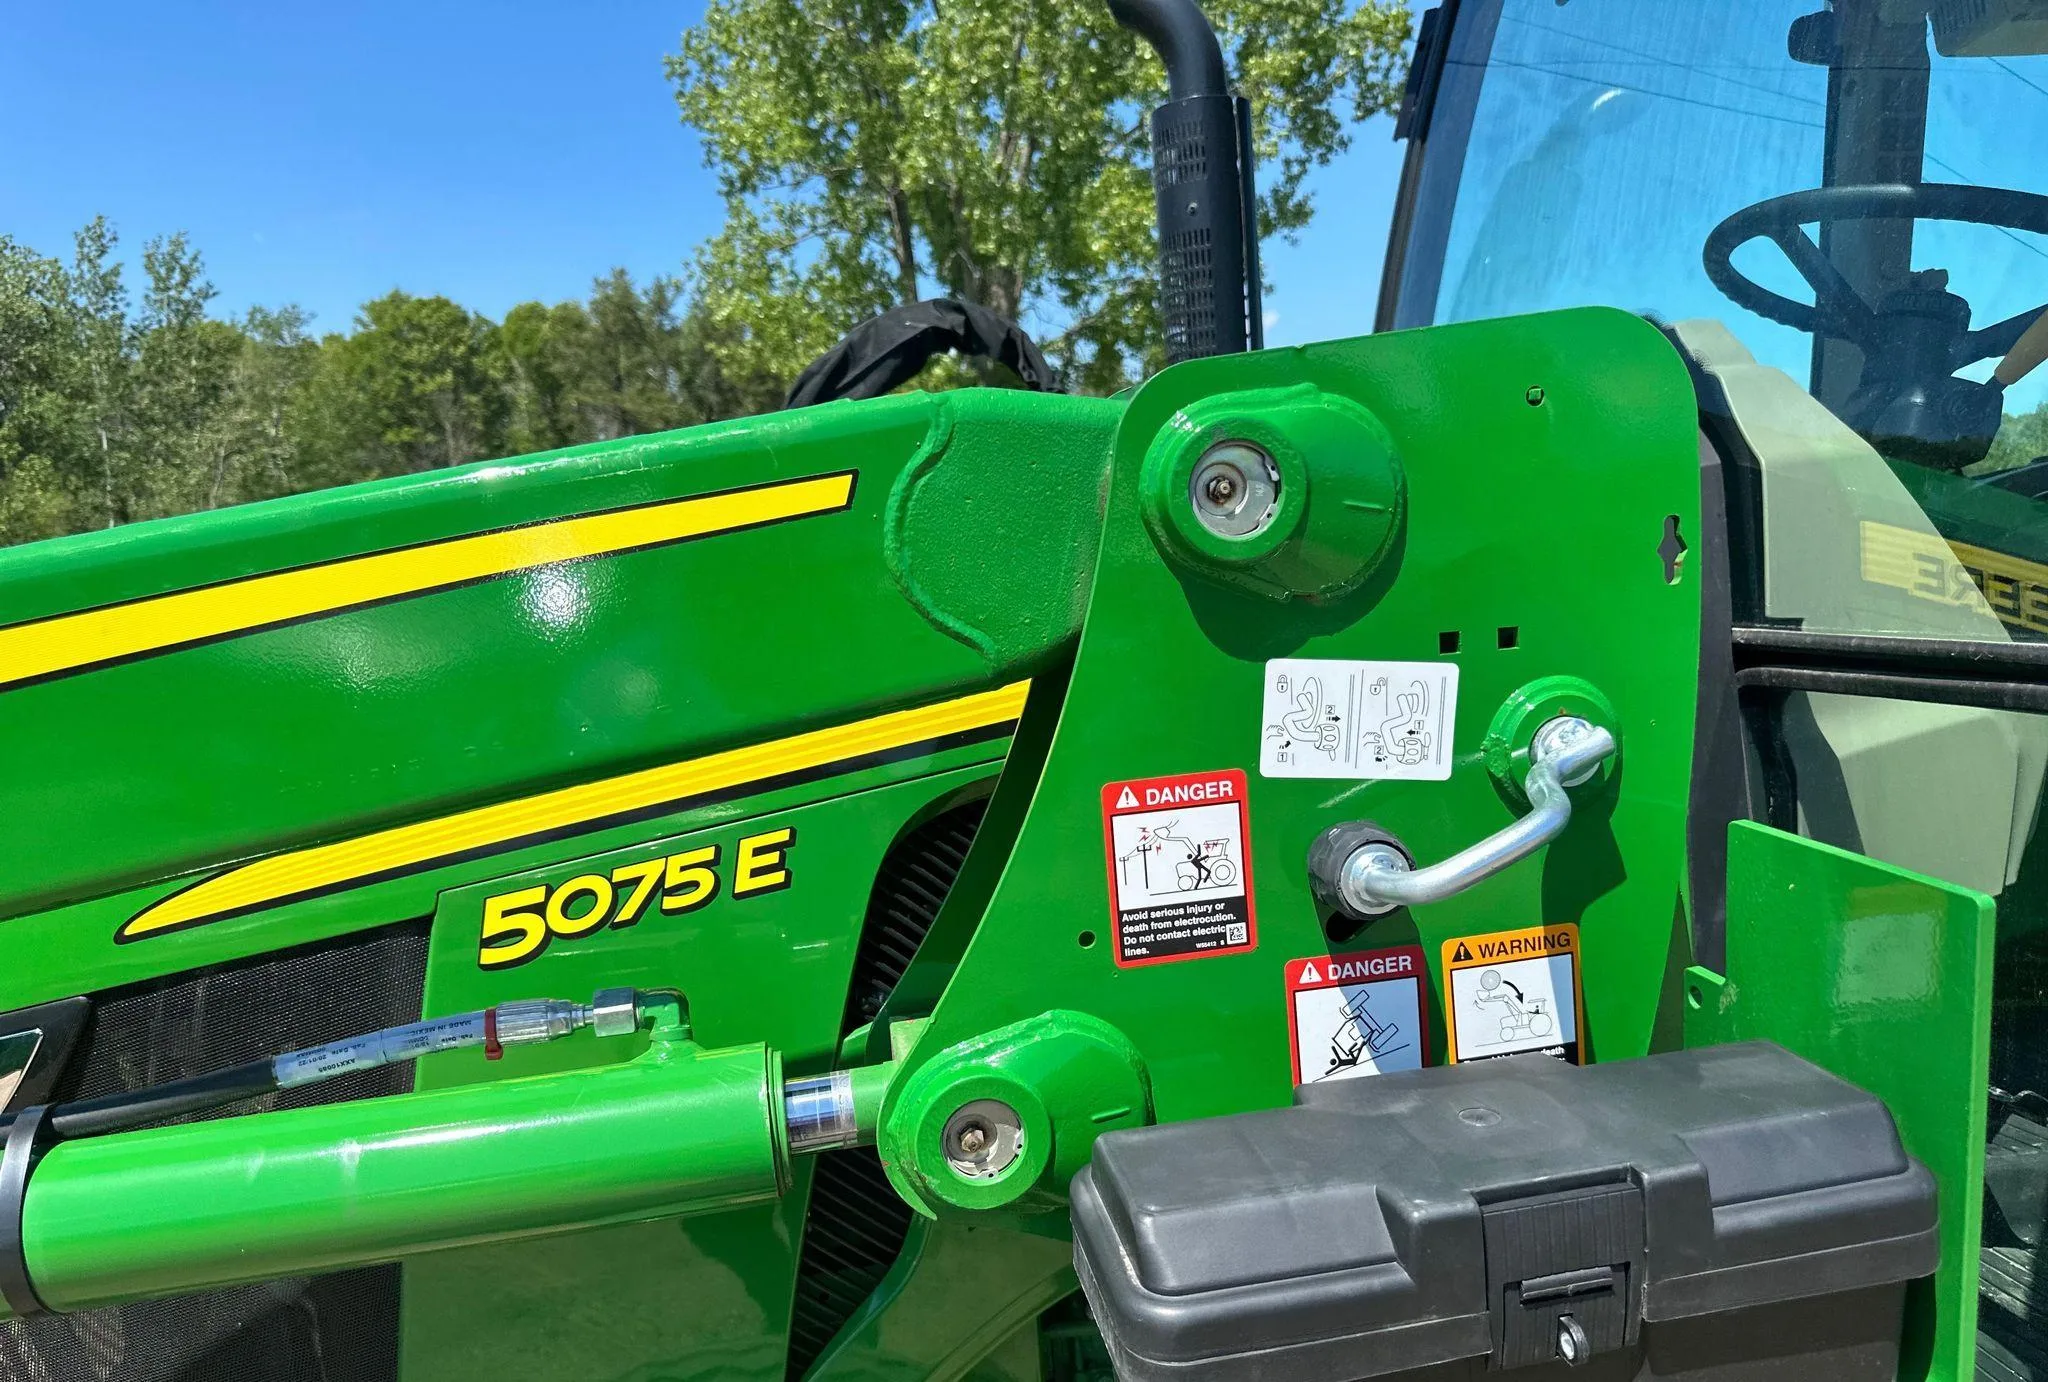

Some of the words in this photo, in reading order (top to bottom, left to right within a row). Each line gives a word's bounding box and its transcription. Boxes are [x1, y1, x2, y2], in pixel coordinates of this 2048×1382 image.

[1145, 780, 1234, 806] DANGER
[478, 843, 722, 972] 5075
[732, 826, 797, 900] E
[1121, 911, 1149, 923] Avoid
[1150, 906, 1185, 919] serious
[1186, 904, 1213, 916] injury
[1215, 902, 1226, 911] or
[1122, 923, 1149, 934] death
[1150, 919, 1173, 930] from
[1174, 913, 1237, 927] electrocution.
[1123, 936, 1137, 946] Do
[1138, 933, 1155, 943] not
[1156, 929, 1191, 941] contact
[1192, 924, 1226, 937] electric
[1477, 931, 1572, 959] WARNING
[1124, 946, 1150, 957] lines.
[1327, 954, 1413, 981] DANGER
